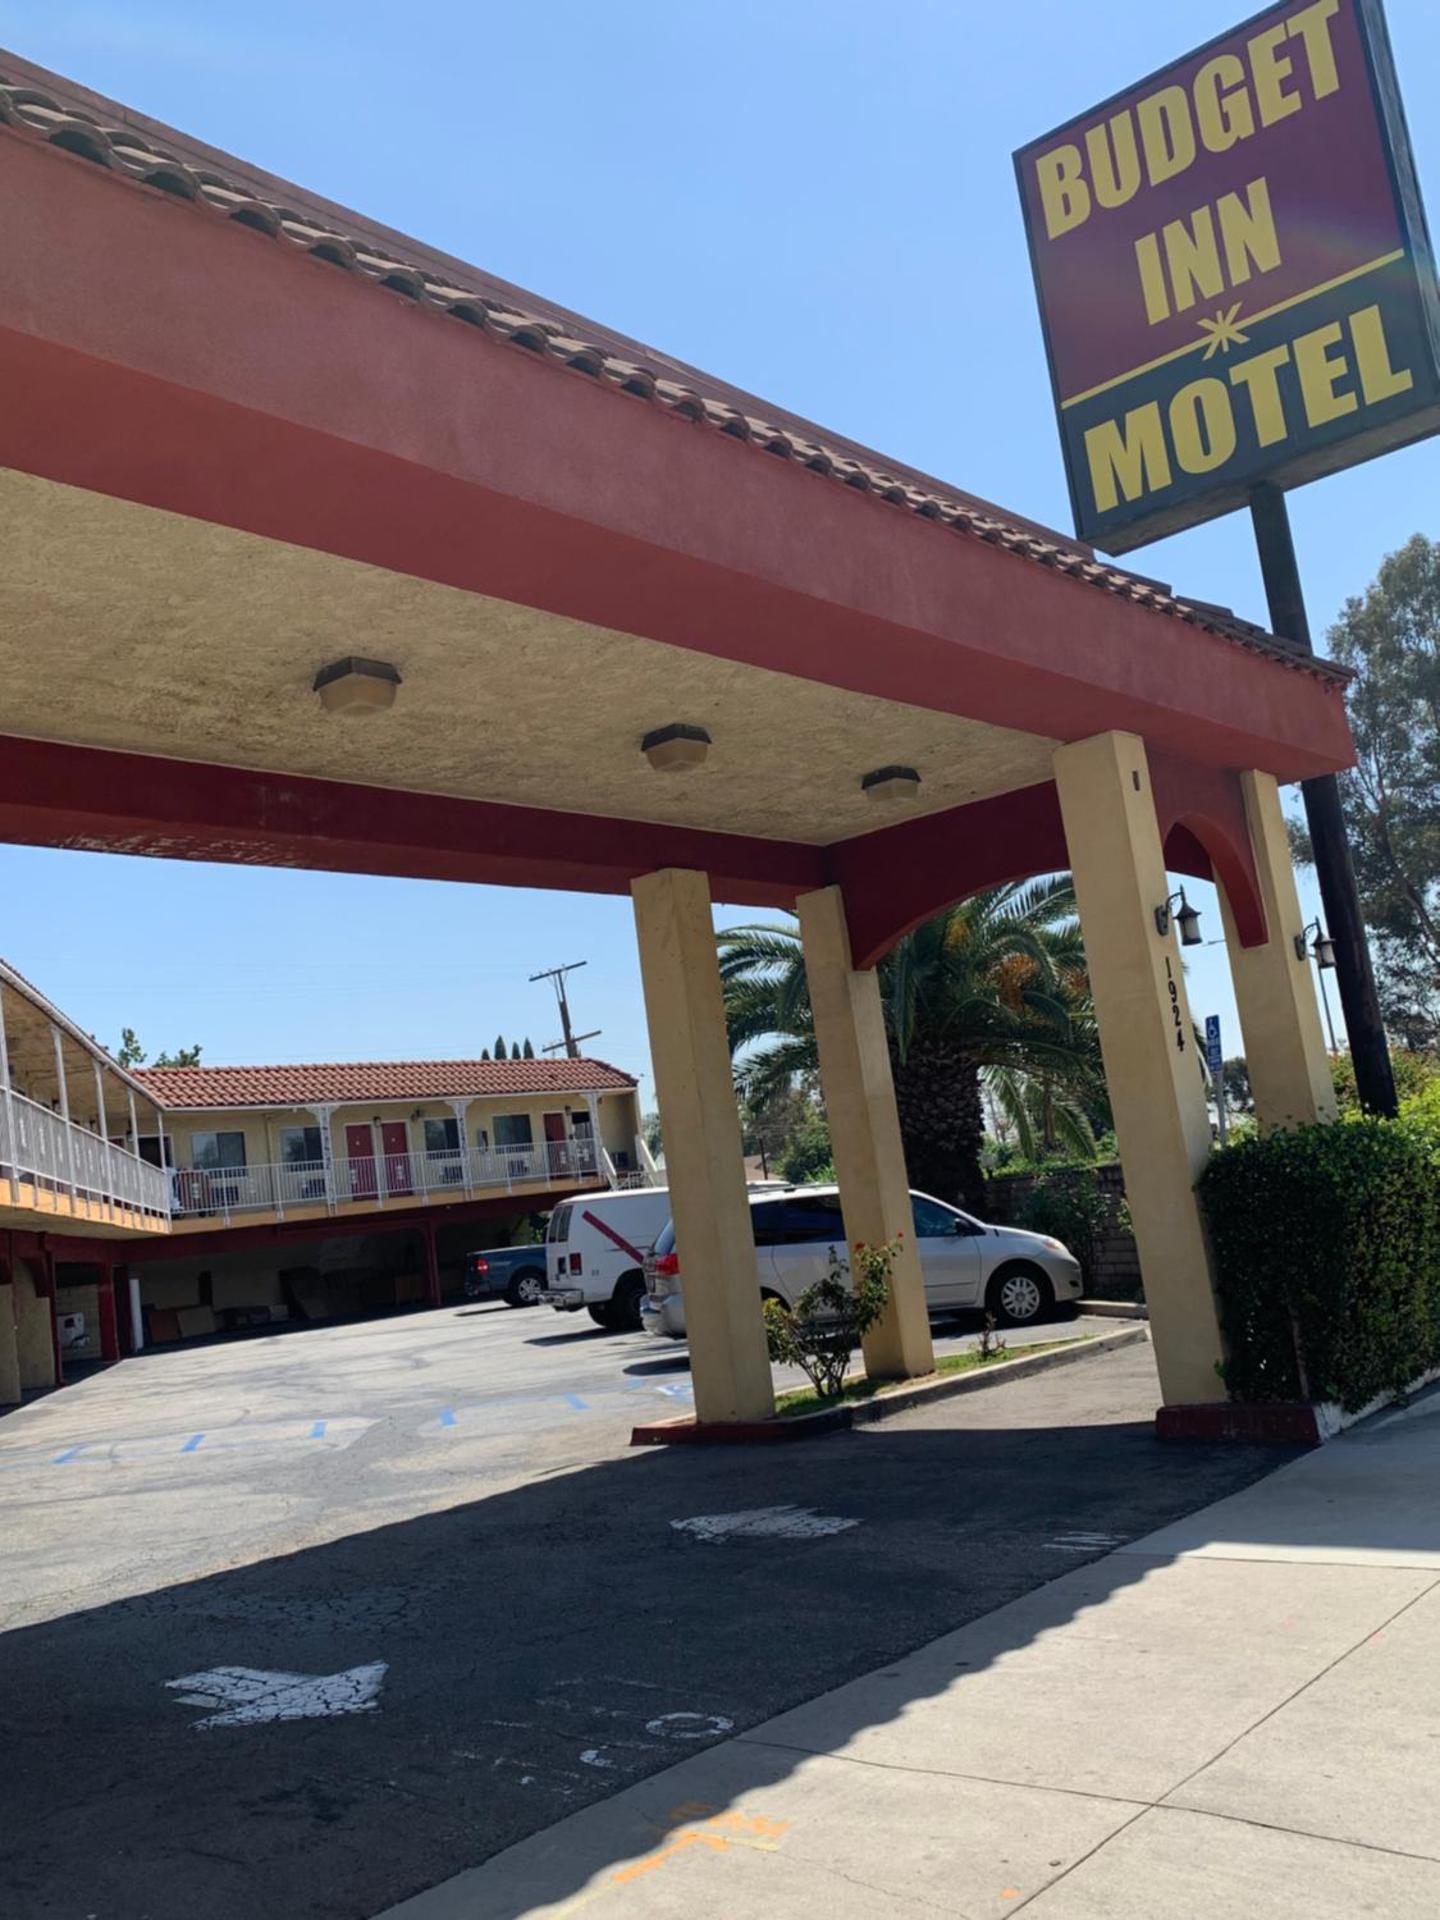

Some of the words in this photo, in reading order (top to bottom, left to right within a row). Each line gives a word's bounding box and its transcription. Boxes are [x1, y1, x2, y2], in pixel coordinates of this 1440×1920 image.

[1035, 0, 1340, 241] BUDGET
[1134, 176, 1281, 325] INN
[1083, 304, 1413, 513] MOTEL
[1165, 955, 1184, 1052] 1924
